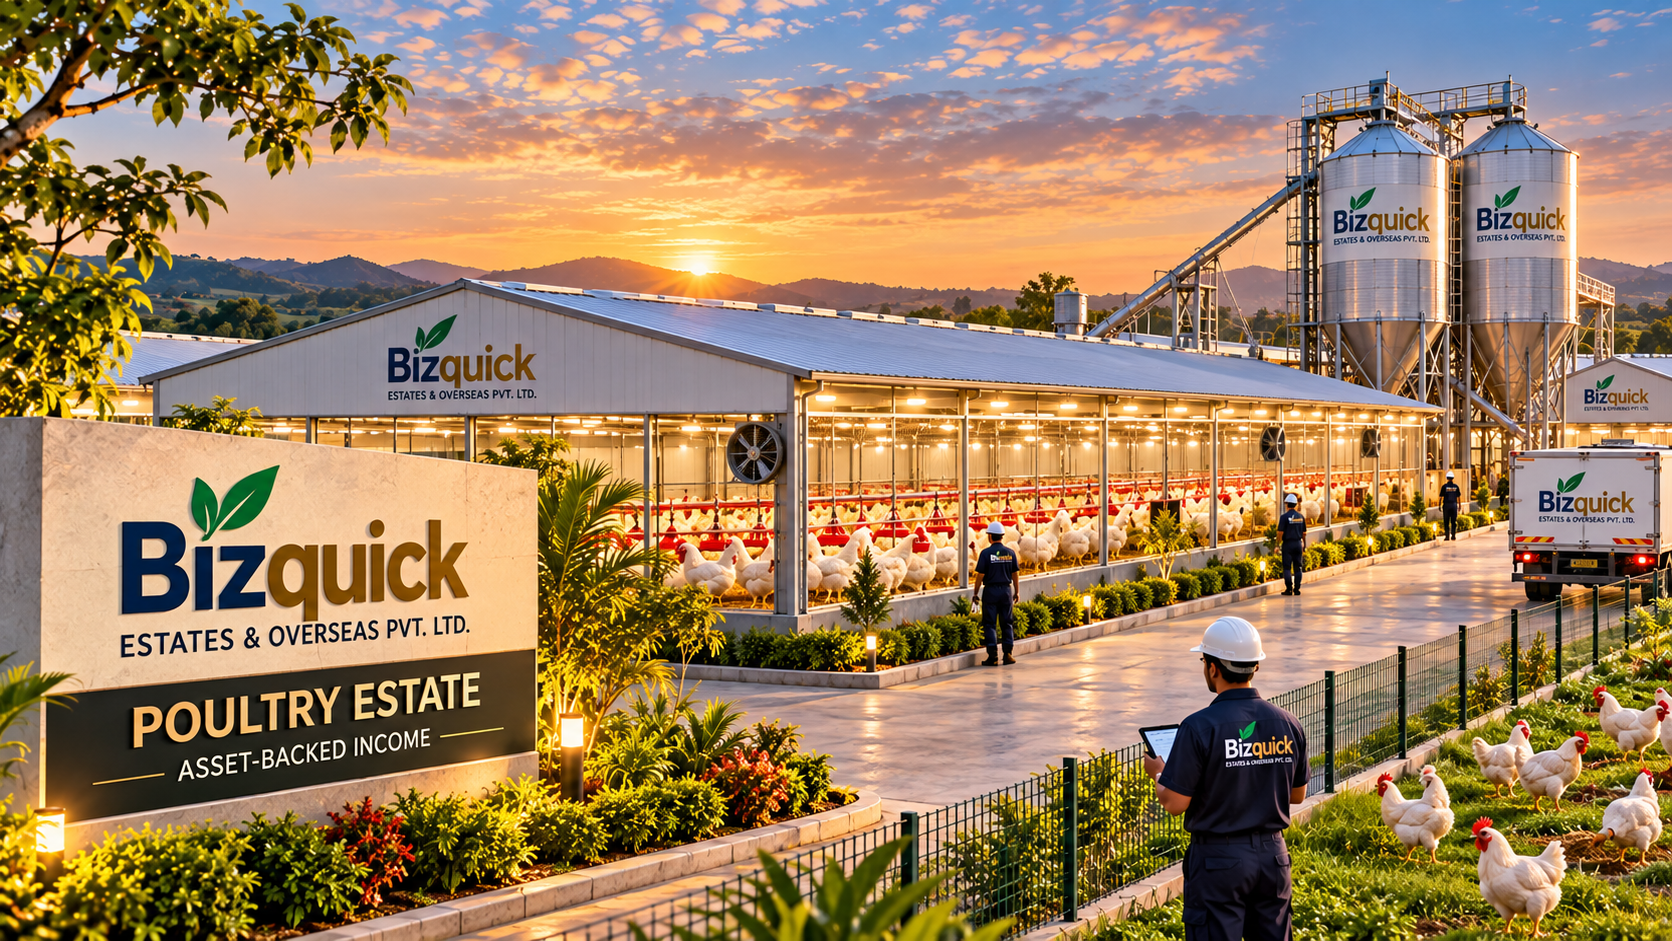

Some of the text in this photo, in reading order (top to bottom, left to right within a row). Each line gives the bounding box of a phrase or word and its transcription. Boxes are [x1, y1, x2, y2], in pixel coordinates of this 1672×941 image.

[1333, 206, 1430, 235] Bizquick
[1476, 206, 1566, 234] Bizquick
[1333, 236, 1358, 246] ESTATES
[1366, 235, 1402, 243] OVERSEAS
[1476, 234, 1503, 243] ESTATES
[1504, 233, 1509, 241] &
[1510, 233, 1543, 241] OVERSEAS
[388, 343, 537, 389] Bizquick
[388, 388, 537, 401] ESTATES & OVERSEAS PVT. LTD.
[1584, 388, 1649, 406] Bizquick
[1539, 490, 1635, 516] Bizquick
[1538, 515, 1565, 523] ESTATES
[1566, 515, 1571, 523] &
[1606, 516, 1620, 524] PVT.
[121, 519, 469, 622] Bizquick
[120, 615, 470, 658] ESTATES & OVERSEAS PVT. LTD.
[132, 671, 481, 749] POULTRY ESTATE
[177, 727, 431, 782] ASSET-BACKED INCOME
[1225, 735, 1294, 759] Bizquick
